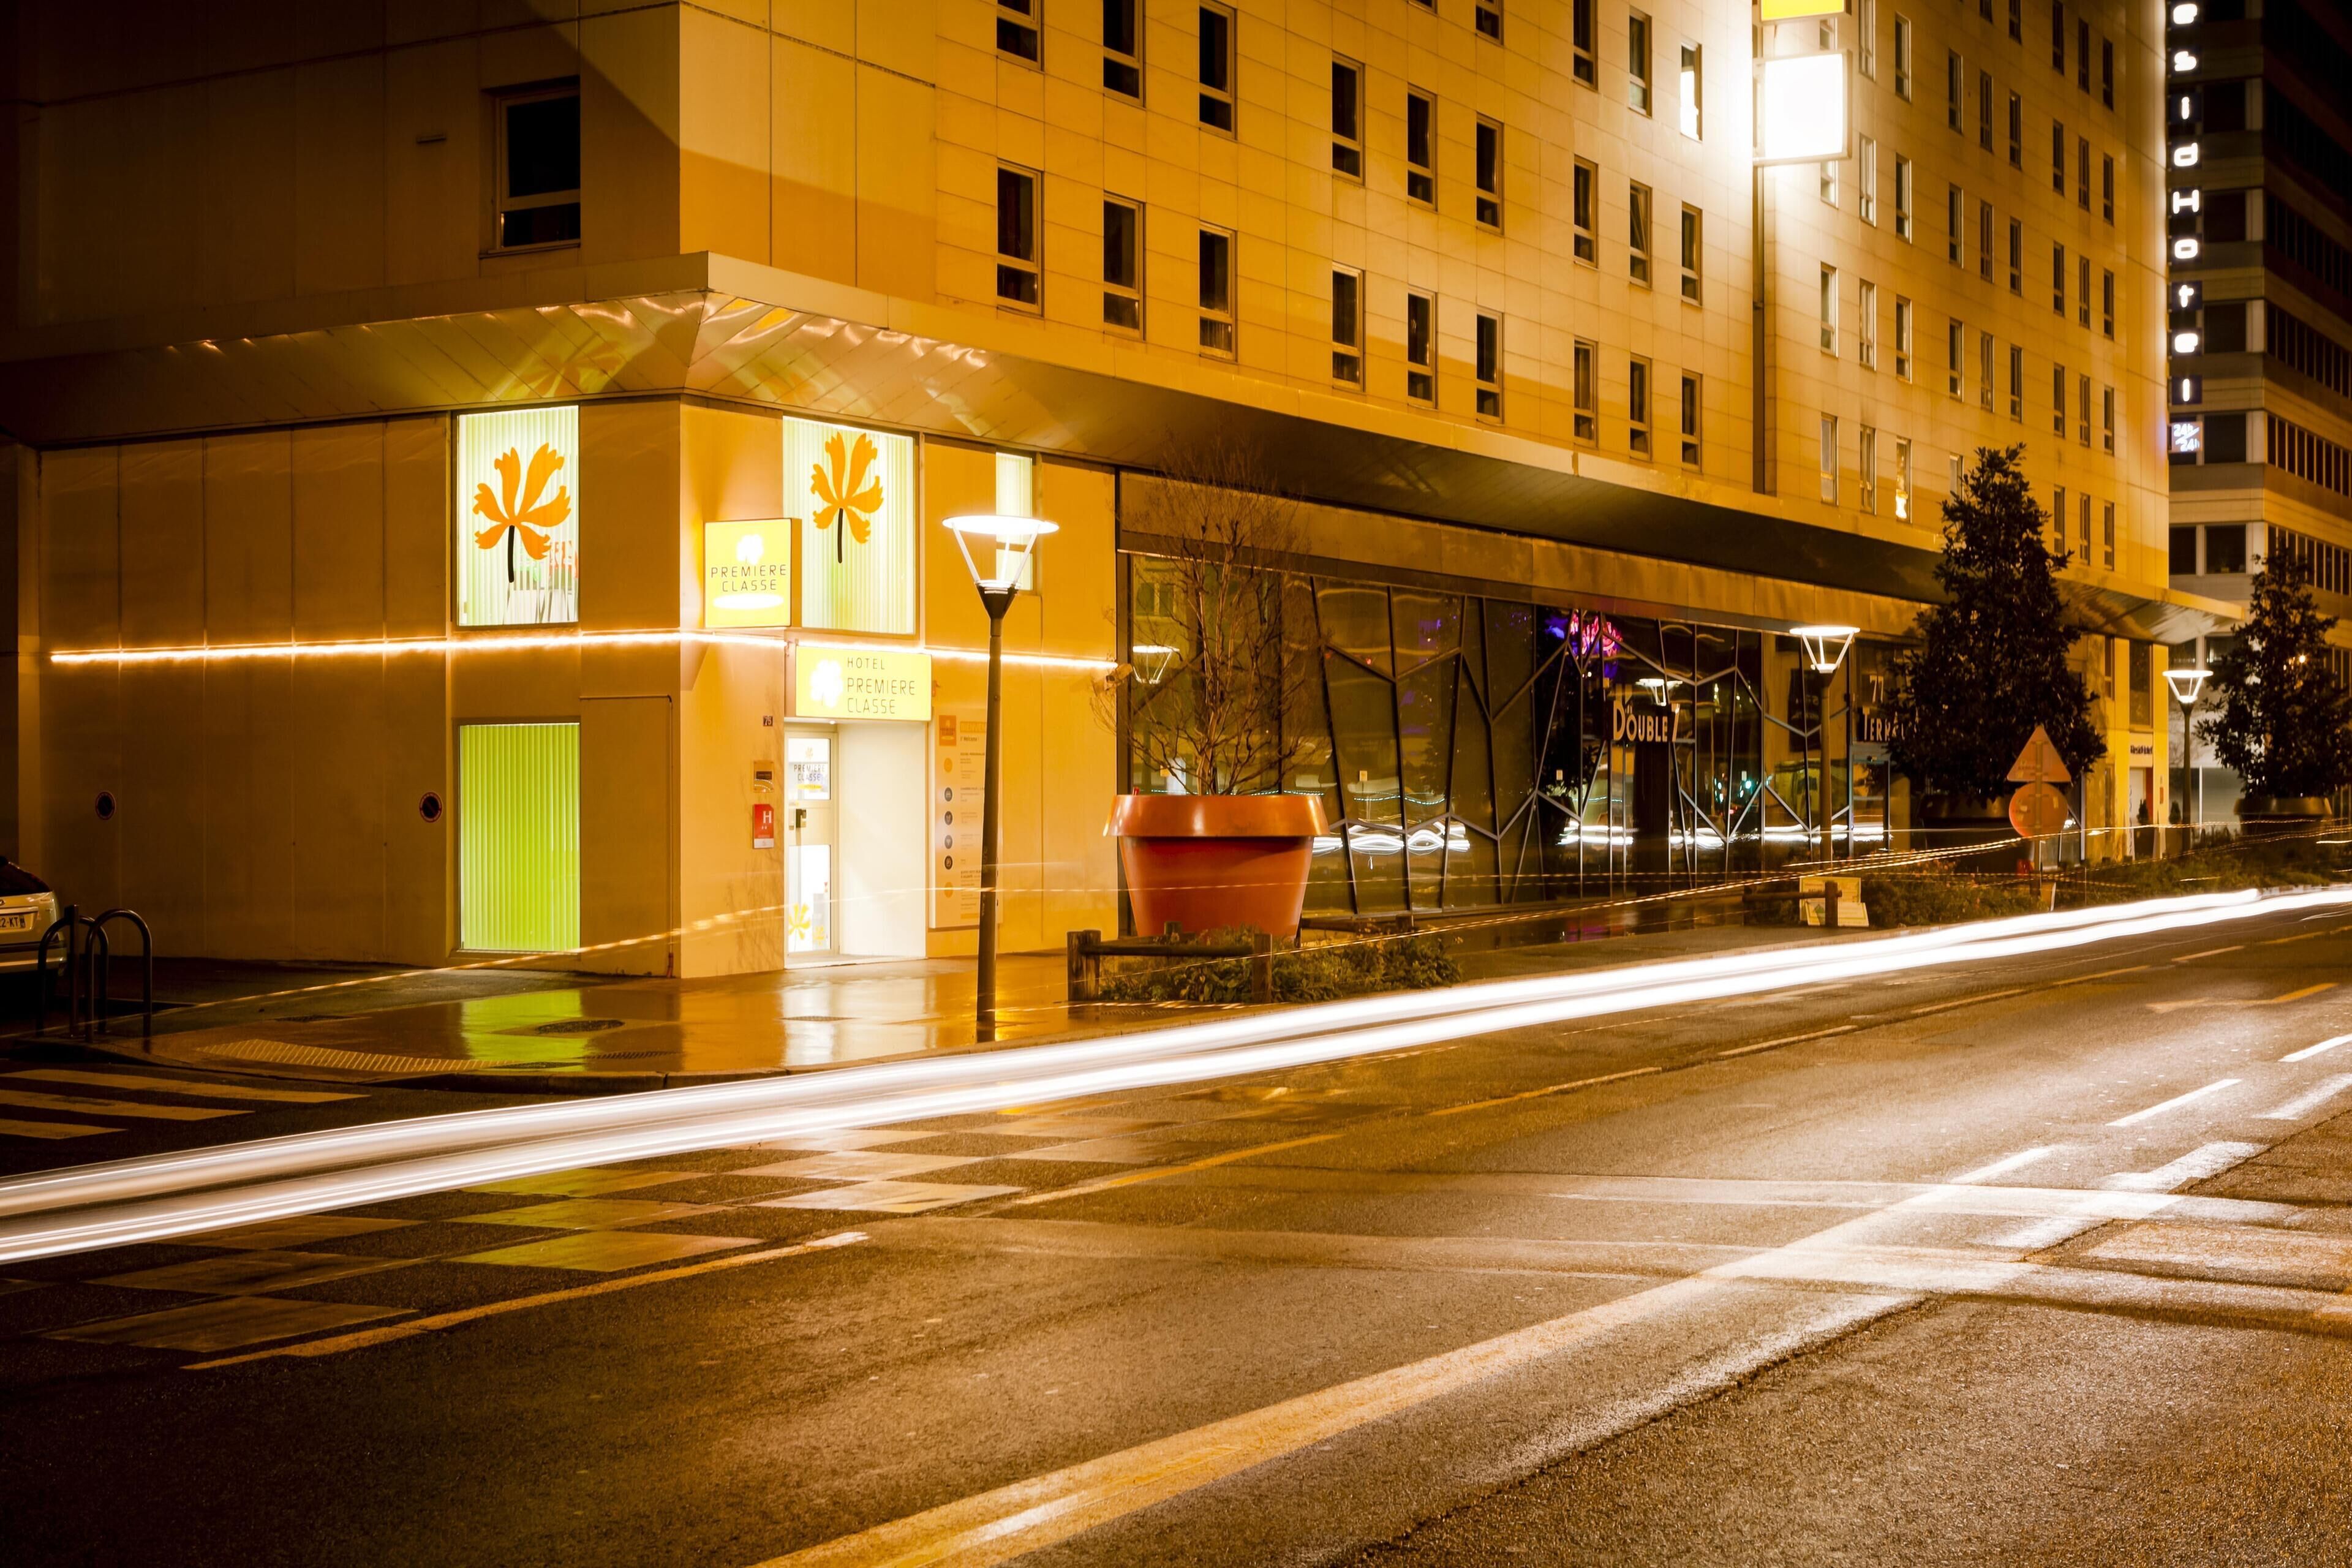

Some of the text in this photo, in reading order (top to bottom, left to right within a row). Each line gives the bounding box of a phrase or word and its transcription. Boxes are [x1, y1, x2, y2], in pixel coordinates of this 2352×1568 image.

[711, 564, 787, 578] PREMIERE
[722, 579, 777, 592] CLASSE
[847, 657, 886, 671] HOTEL
[847, 677, 916, 696] PREMIERE
[847, 697, 896, 715] CLASSE
[797, 773, 821, 782] CLASSE
[763, 810, 772, 824] H
